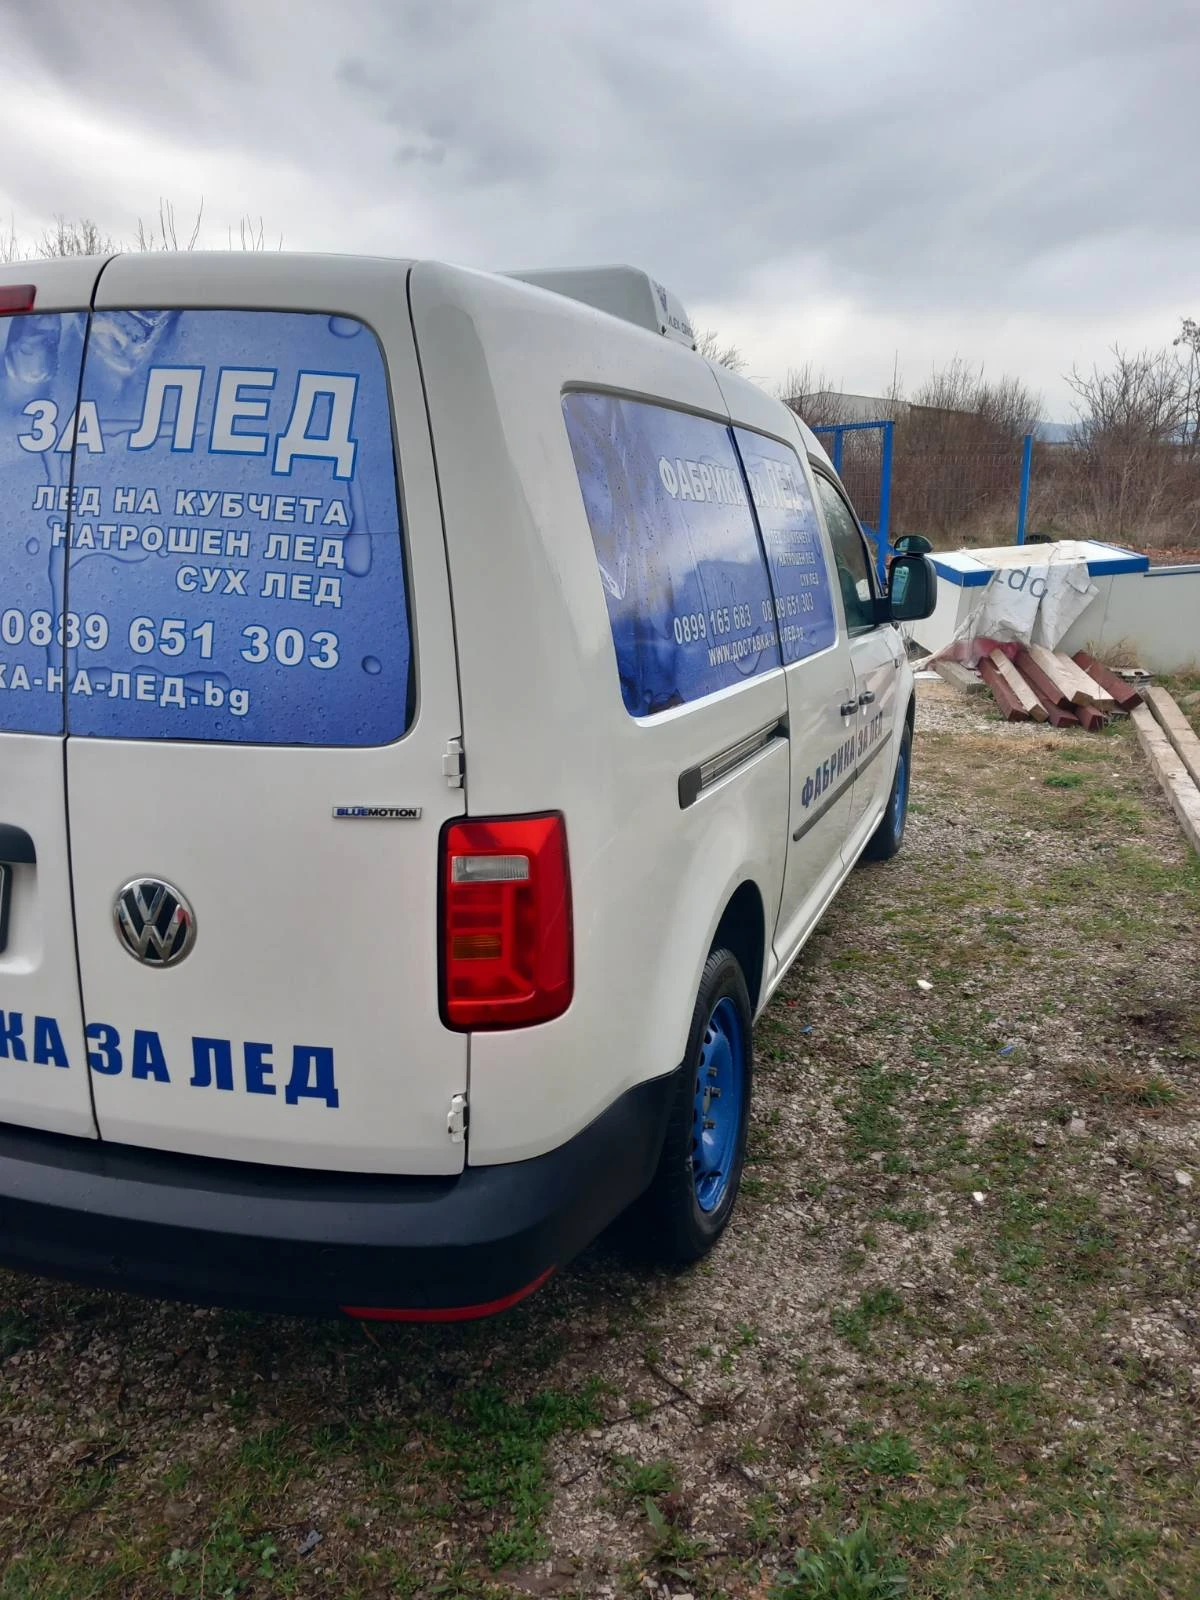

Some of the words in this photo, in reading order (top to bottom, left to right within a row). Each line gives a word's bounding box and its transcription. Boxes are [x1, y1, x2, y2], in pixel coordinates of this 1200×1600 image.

[17, 398, 105, 454] ЗА
[127, 365, 360, 481] ЛЕД
[33, 485, 101, 517] ЛЕД
[113, 487, 161, 515] НА
[174, 488, 350, 527] КУБЧЕТА
[658, 455, 748, 507] ФАБРИКА
[51, 522, 250, 558] НАТРОШЕН
[263, 532, 346, 569] ЛЕД
[176, 565, 250, 597] СУХ
[261, 572, 344, 609] ЛЕД
[1, 608, 110, 651] 0889
[128, 616, 215, 659] 651
[240, 624, 340, 670] 303
[673, 612, 707, 645] 0899
[710, 606, 731, 635] 165
[733, 602, 752, 630] 683
[787, 594, 801, 617] 651
[801, 736, 856, 808] ФАБРИКА
[858, 725, 869, 758] ЗА
[336, 807, 417, 817] BLUEMOTION
[0, 1009, 71, 1069] КА
[85, 1022, 171, 1084] ЗА
[190, 1036, 340, 1108] ЛЕД
